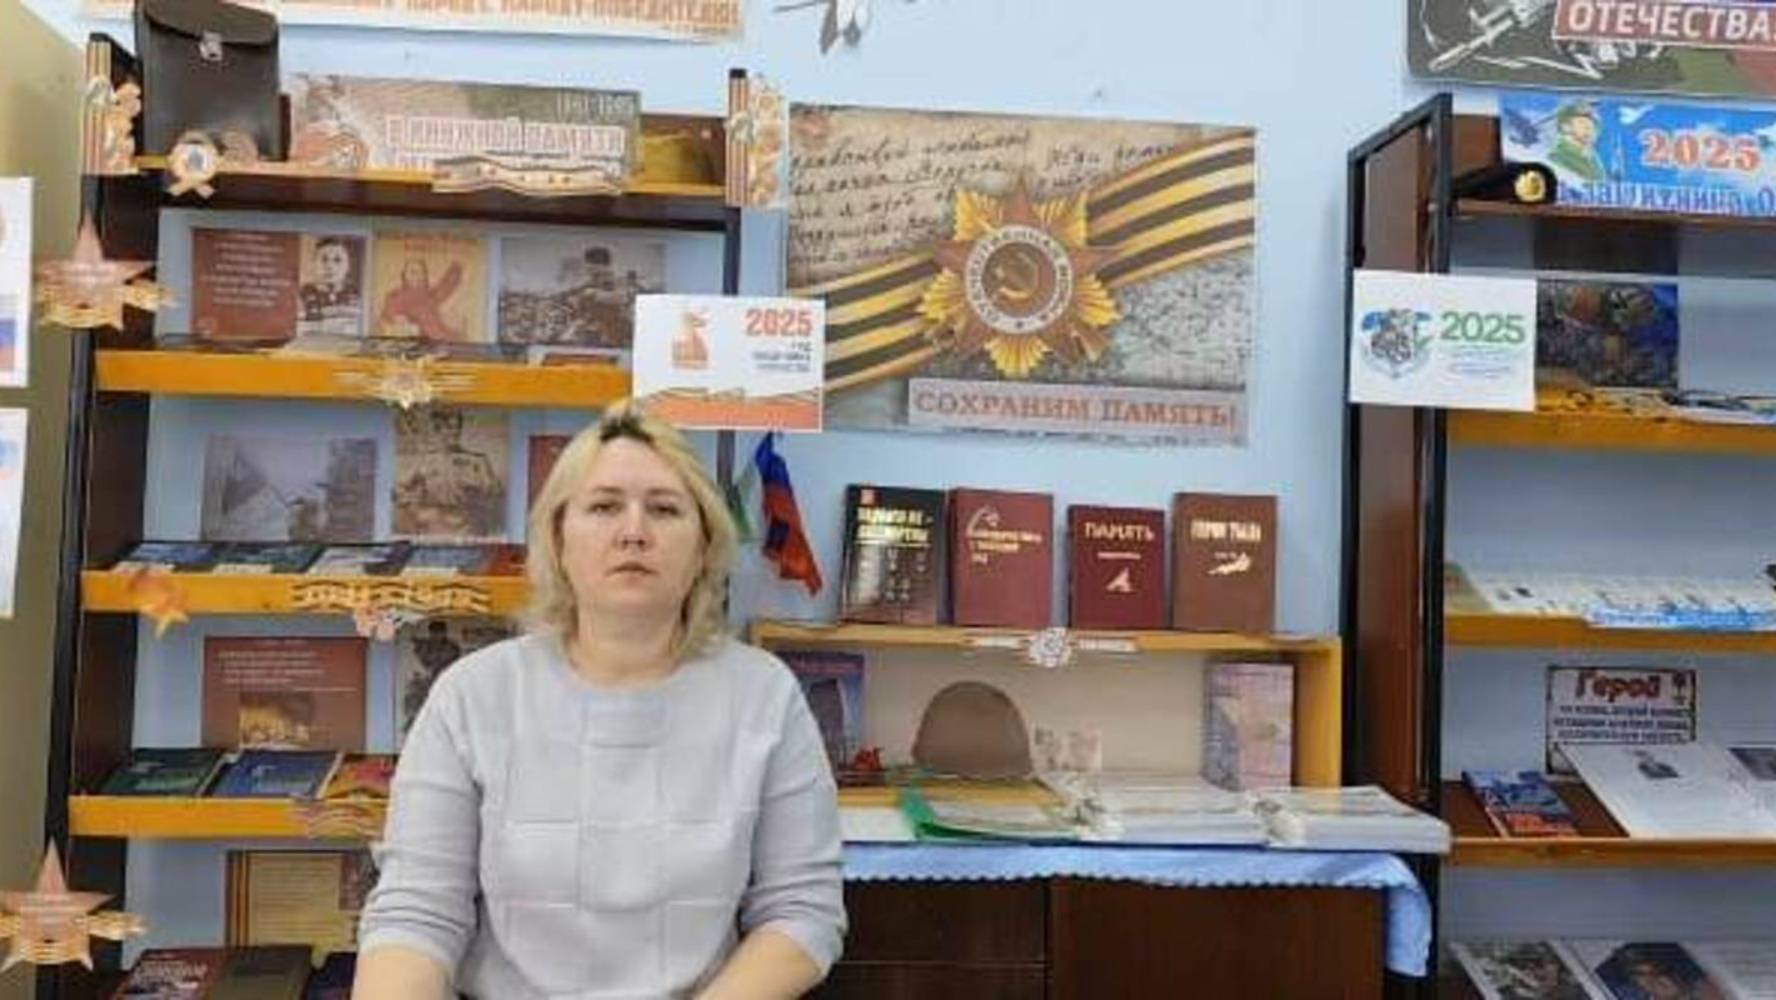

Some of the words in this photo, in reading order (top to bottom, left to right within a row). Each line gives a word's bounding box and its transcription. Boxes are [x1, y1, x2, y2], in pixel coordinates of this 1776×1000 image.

[1642, 130, 1761, 173] 2025
[744, 307, 813, 337] 2025
[1440, 311, 1527, 344] 2025
[915, 390, 1090, 421] СОХРАНИМ
[1101, 397, 1236, 430] ПАМЯТЬ!
[1085, 520, 1155, 541] ПАМЯТЬ
